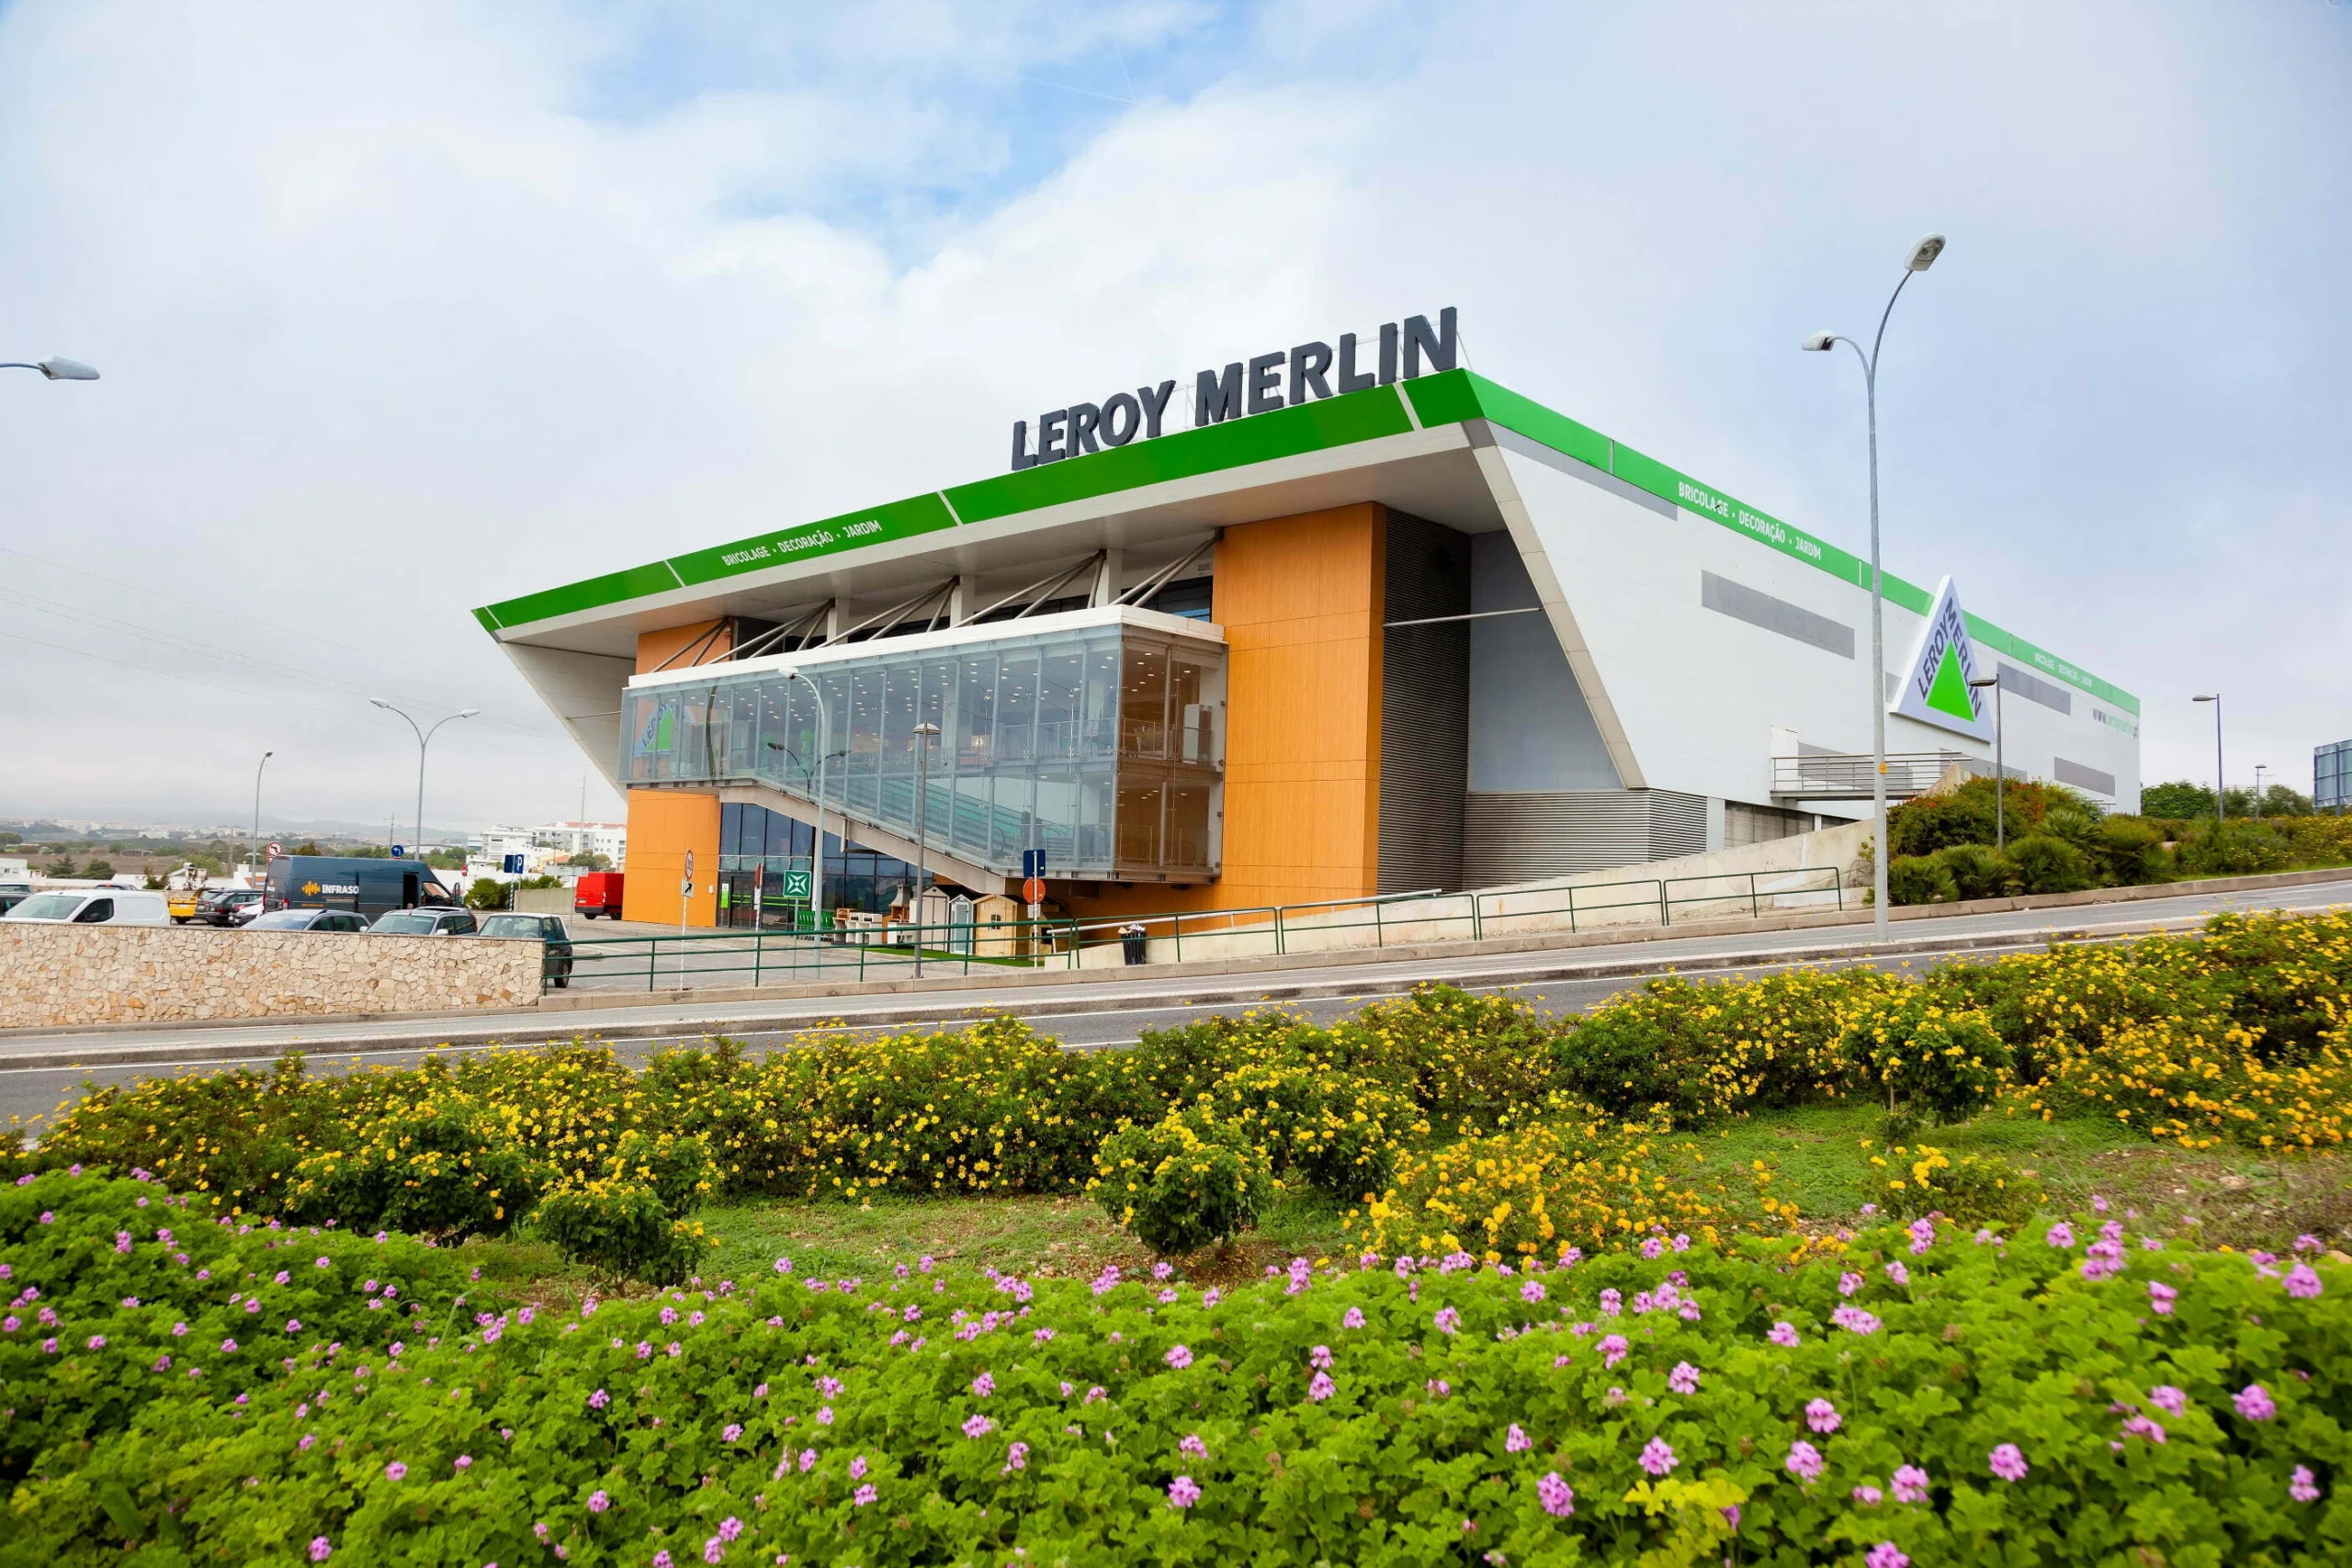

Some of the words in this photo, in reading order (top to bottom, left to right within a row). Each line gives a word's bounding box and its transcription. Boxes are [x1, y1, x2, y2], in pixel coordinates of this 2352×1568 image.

[1012, 379, 1176, 471] LEROY
[1194, 306, 1457, 427] MERLIN
[721, 546, 771, 566] BRICOLAGE
[776, 529, 834, 554] DECORAÇÃO
[842, 519, 882, 538] JARDIM
[1679, 480, 1729, 517] BRICOLAGE
[1738, 509, 1785, 544] DECORAÇÃO
[1795, 536, 1821, 560] JARDIM
[1917, 614, 1949, 700] LEROY
[1945, 597, 1982, 717] MERLIN
[322, 884, 359, 895] INFRASO
